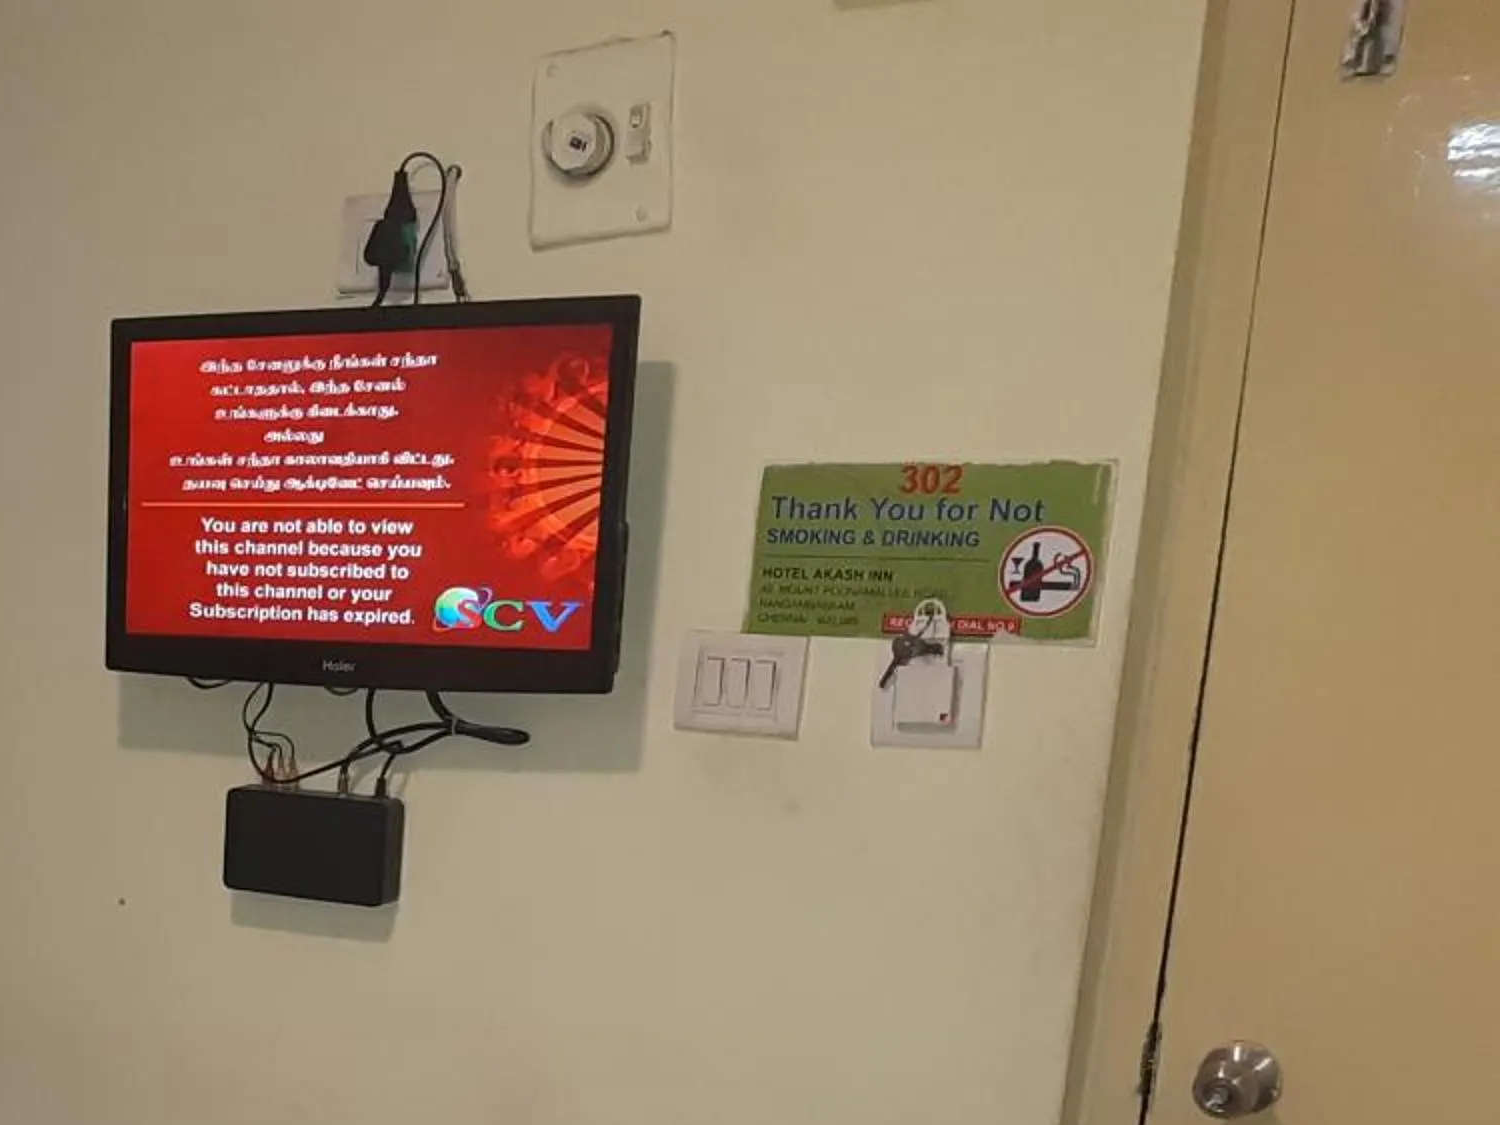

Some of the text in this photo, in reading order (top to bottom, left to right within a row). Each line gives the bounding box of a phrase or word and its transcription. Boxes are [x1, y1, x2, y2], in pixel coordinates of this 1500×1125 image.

[901, 464, 964, 494] 302
[772, 496, 1045, 523] Thank You for Not
[200, 517, 414, 535] You are not able to view
[767, 528, 980, 548] SMOKING & DRINKING
[195, 539, 422, 561] this channel because you
[206, 560, 409, 580] have not subscribed to
[762, 567, 893, 583] HOTEL AKASH INN
[216, 582, 392, 604] this channel or your
[190, 602, 415, 626] Subscription has expired.
[454, 599, 584, 632] SCV
[957, 619, 985, 629] DIAL
